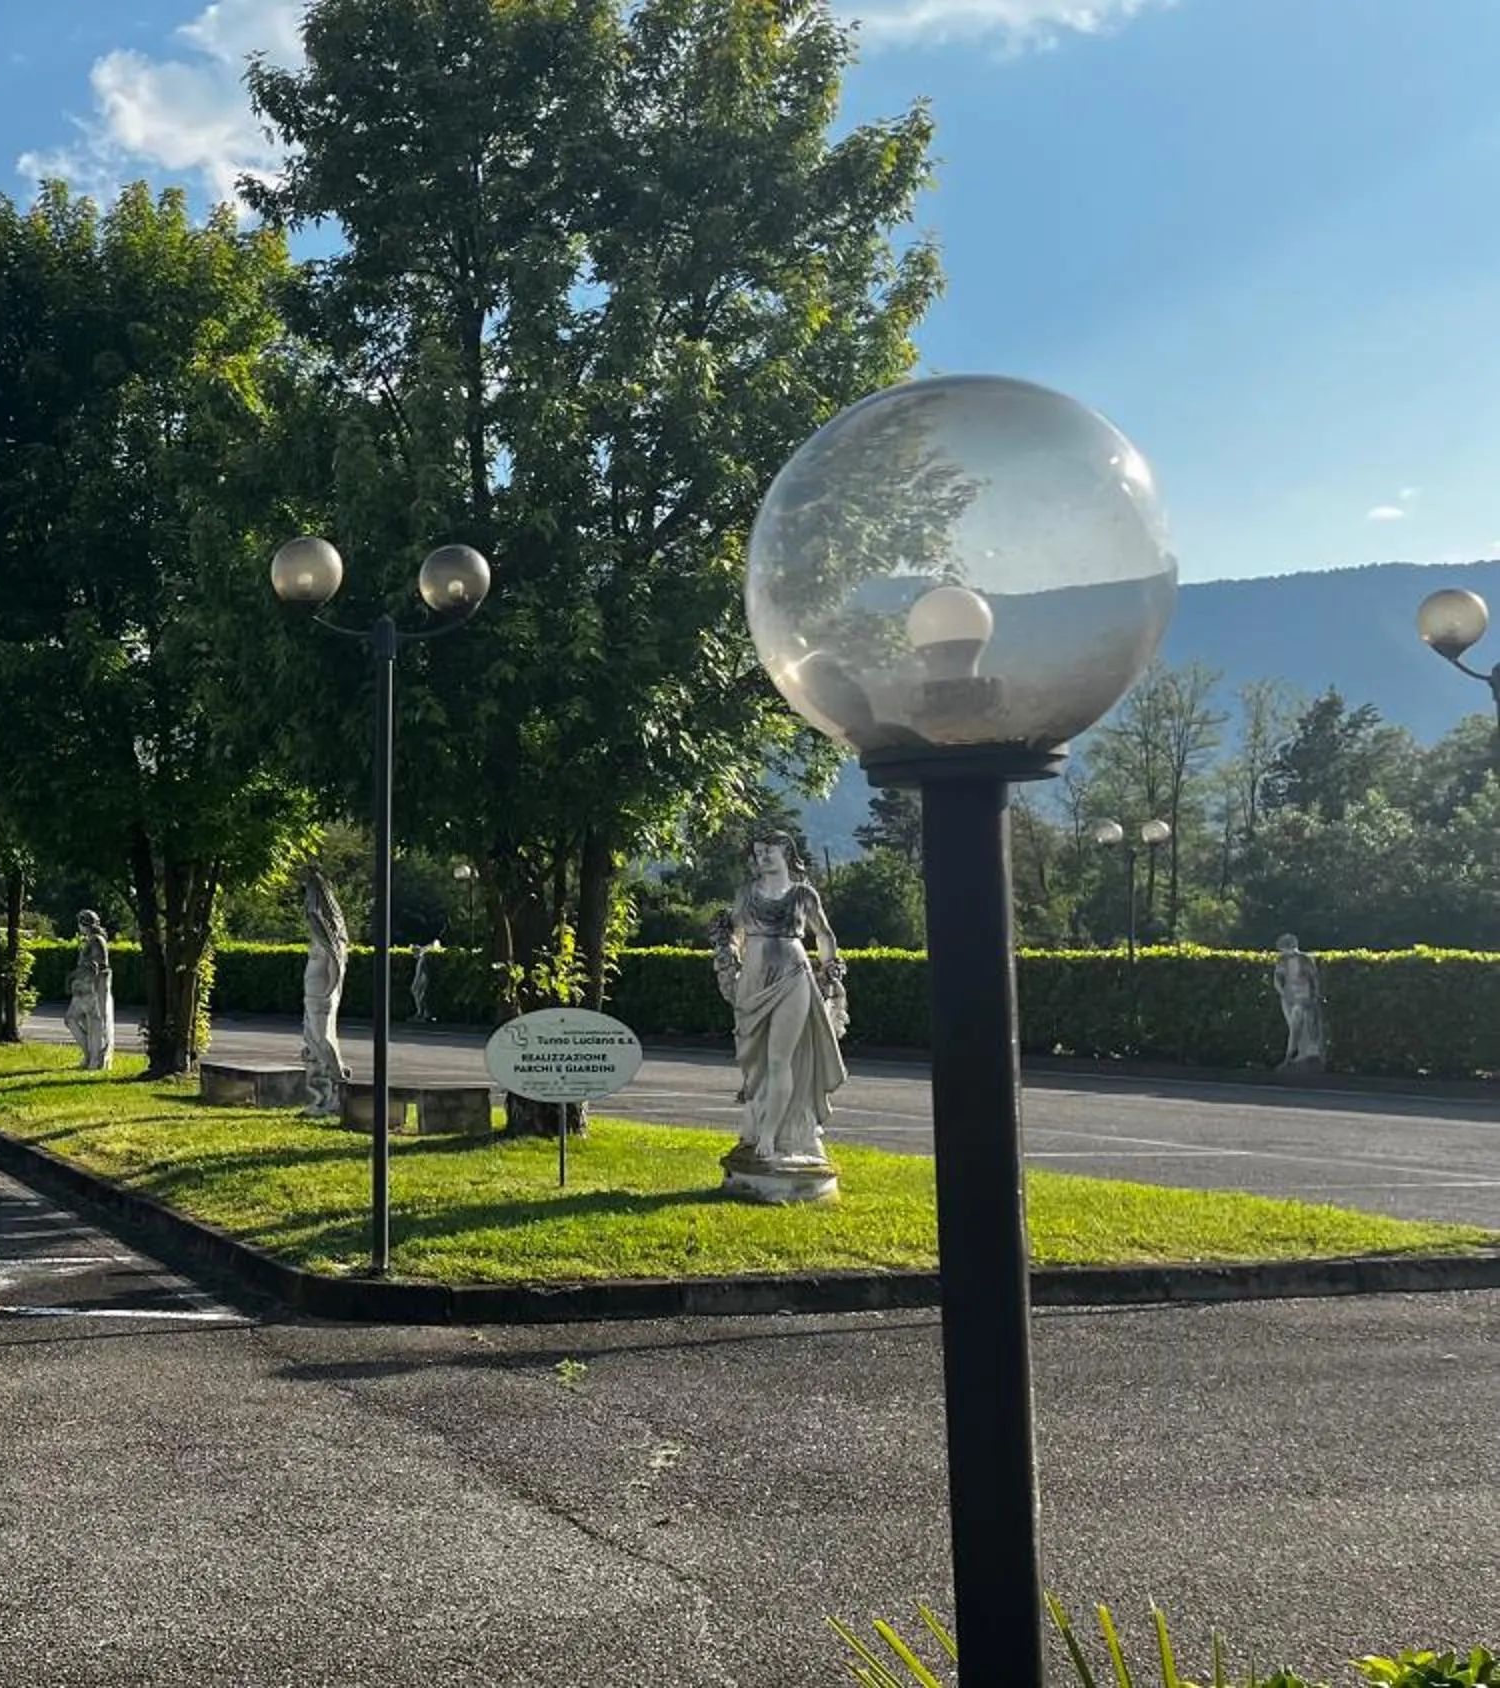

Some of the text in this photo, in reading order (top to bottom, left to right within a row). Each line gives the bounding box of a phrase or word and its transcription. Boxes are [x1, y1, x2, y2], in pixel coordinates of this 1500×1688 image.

[573, 1036, 614, 1045] Luciano
[521, 1053, 607, 1062] REALIZZAZIONE
[513, 1064, 615, 1073] PARCHI E GIARDINI
